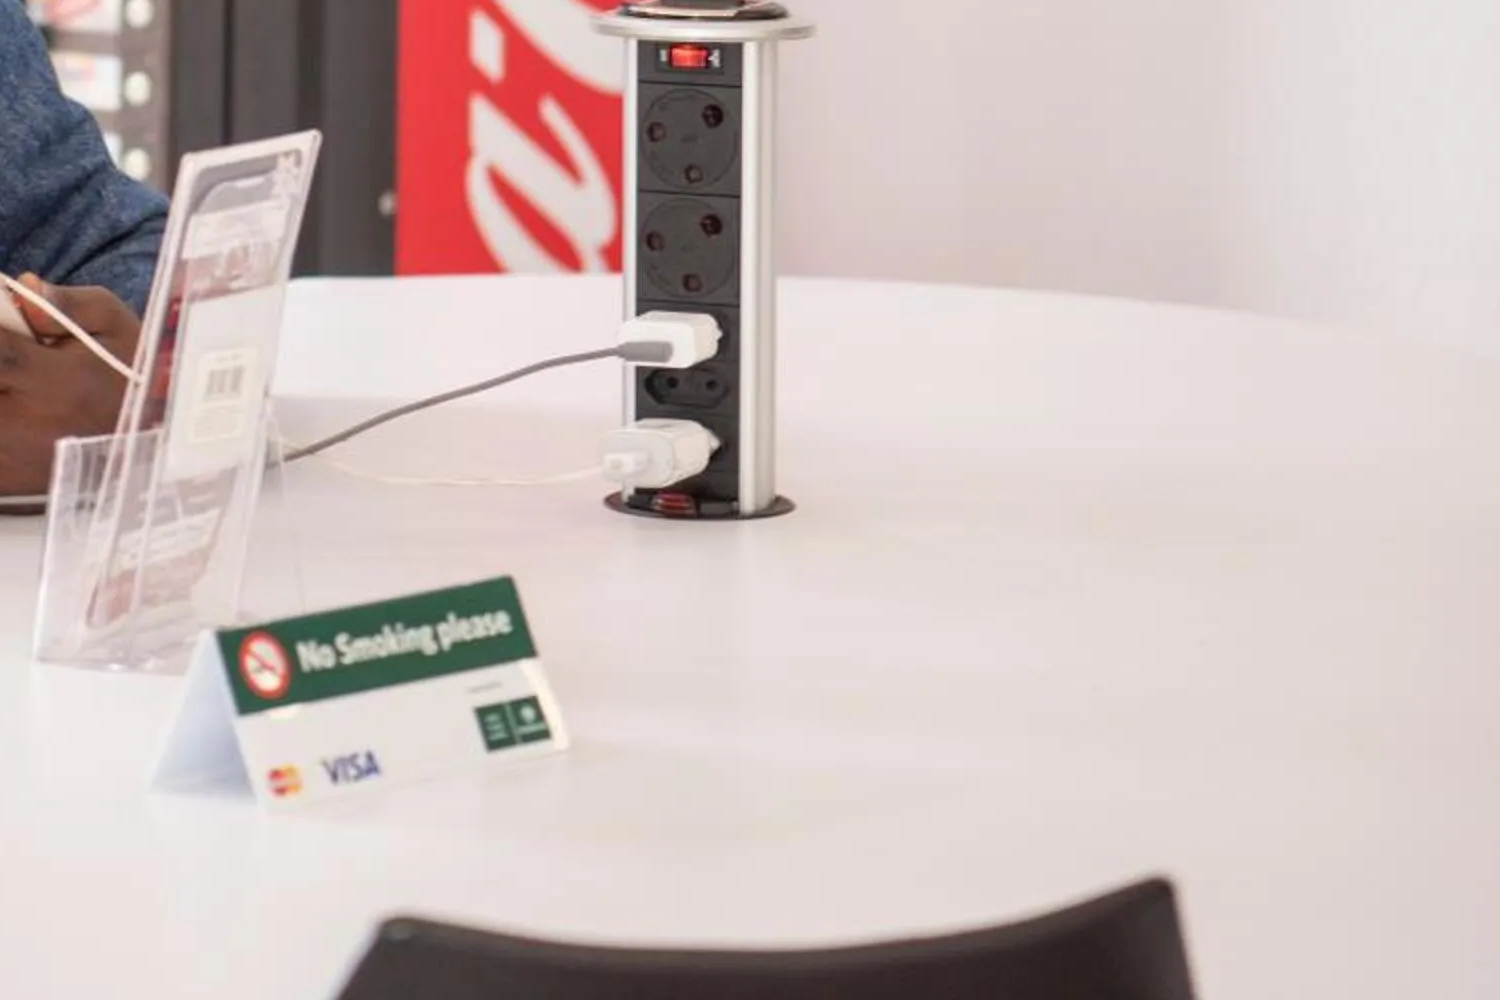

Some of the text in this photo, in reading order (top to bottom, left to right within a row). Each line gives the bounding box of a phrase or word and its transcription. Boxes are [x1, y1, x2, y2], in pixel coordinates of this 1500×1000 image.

[296, 611, 512, 672] No Smoking please
[319, 750, 380, 787] VISA
